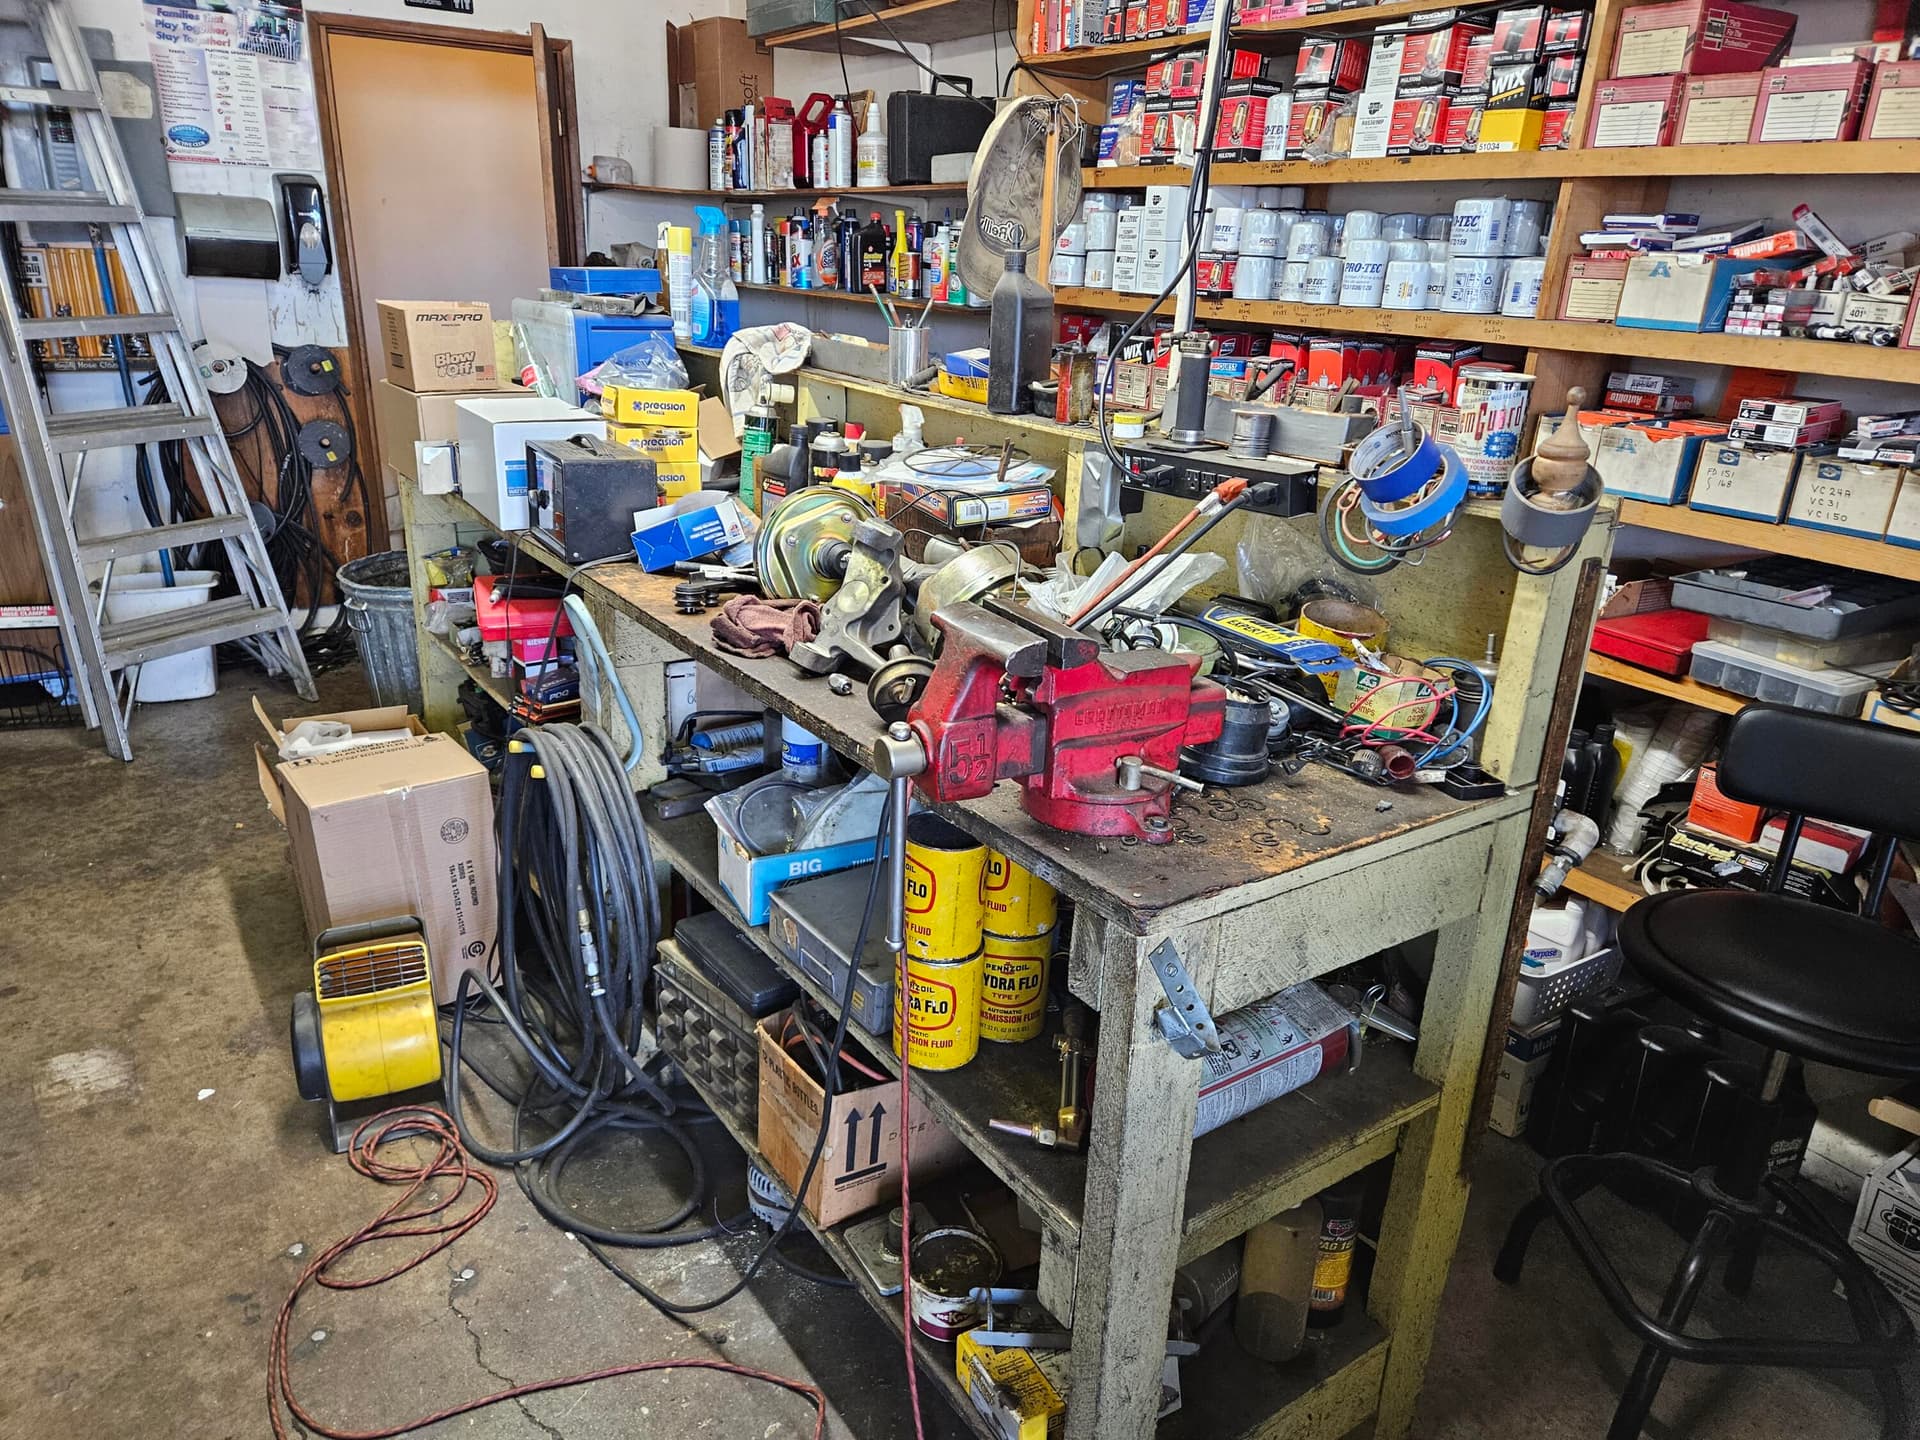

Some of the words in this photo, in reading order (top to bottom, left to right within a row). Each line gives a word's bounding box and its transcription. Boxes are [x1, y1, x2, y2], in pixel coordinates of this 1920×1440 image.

[156, 8, 200, 20] Families
[155, 19, 178, 31] Play
[156, 31, 179, 43] Stay
[183, 34, 231, 47] Tother!
[1492, 70, 1526, 97] WIX
[1478, 142, 1500, 151] 51034
[1345, 262, 1383, 273] PRO-TEC
[416, 313, 449, 322] MAX
[453, 313, 483, 322] PRO
[1123, 342, 1144, 361] WIX
[434, 351, 475, 367] Blow
[643, 402, 686, 412] precision
[1741, 408, 1749, 419] 4
[1731, 428, 1740, 438] 4
[641, 438, 684, 448] precision
[657, 474, 686, 482] cision
[1720, 470, 1735, 478] 151
[1811, 484, 1826, 494] VC
[1809, 497, 1824, 506] VC
[1828, 498, 1840, 508] 31
[1807, 509, 1822, 517] VC
[1826, 511, 1848, 522] 150
[1074, 696, 1170, 726] CRAFTSMAN
[789, 859, 822, 877] BIG
[988, 861, 1002, 876] LO
[907, 878, 928, 898] FLO
[987, 900, 1007, 912] FLUID
[911, 922, 932, 936] FLUID
[986, 963, 1030, 972] PENNZOIL
[983, 972, 1016, 991] YDRA
[1018, 975, 1040, 990] FLO
[992, 991, 1012, 1000] TYPE
[924, 1000, 949, 1015] FLO
[987, 1007, 1022, 1015] AUTOMATIC
[980, 1011, 1020, 1024] NSMISSION
[931, 1039, 953, 1048] FLUID
[888, 1121, 927, 1141] DTE
